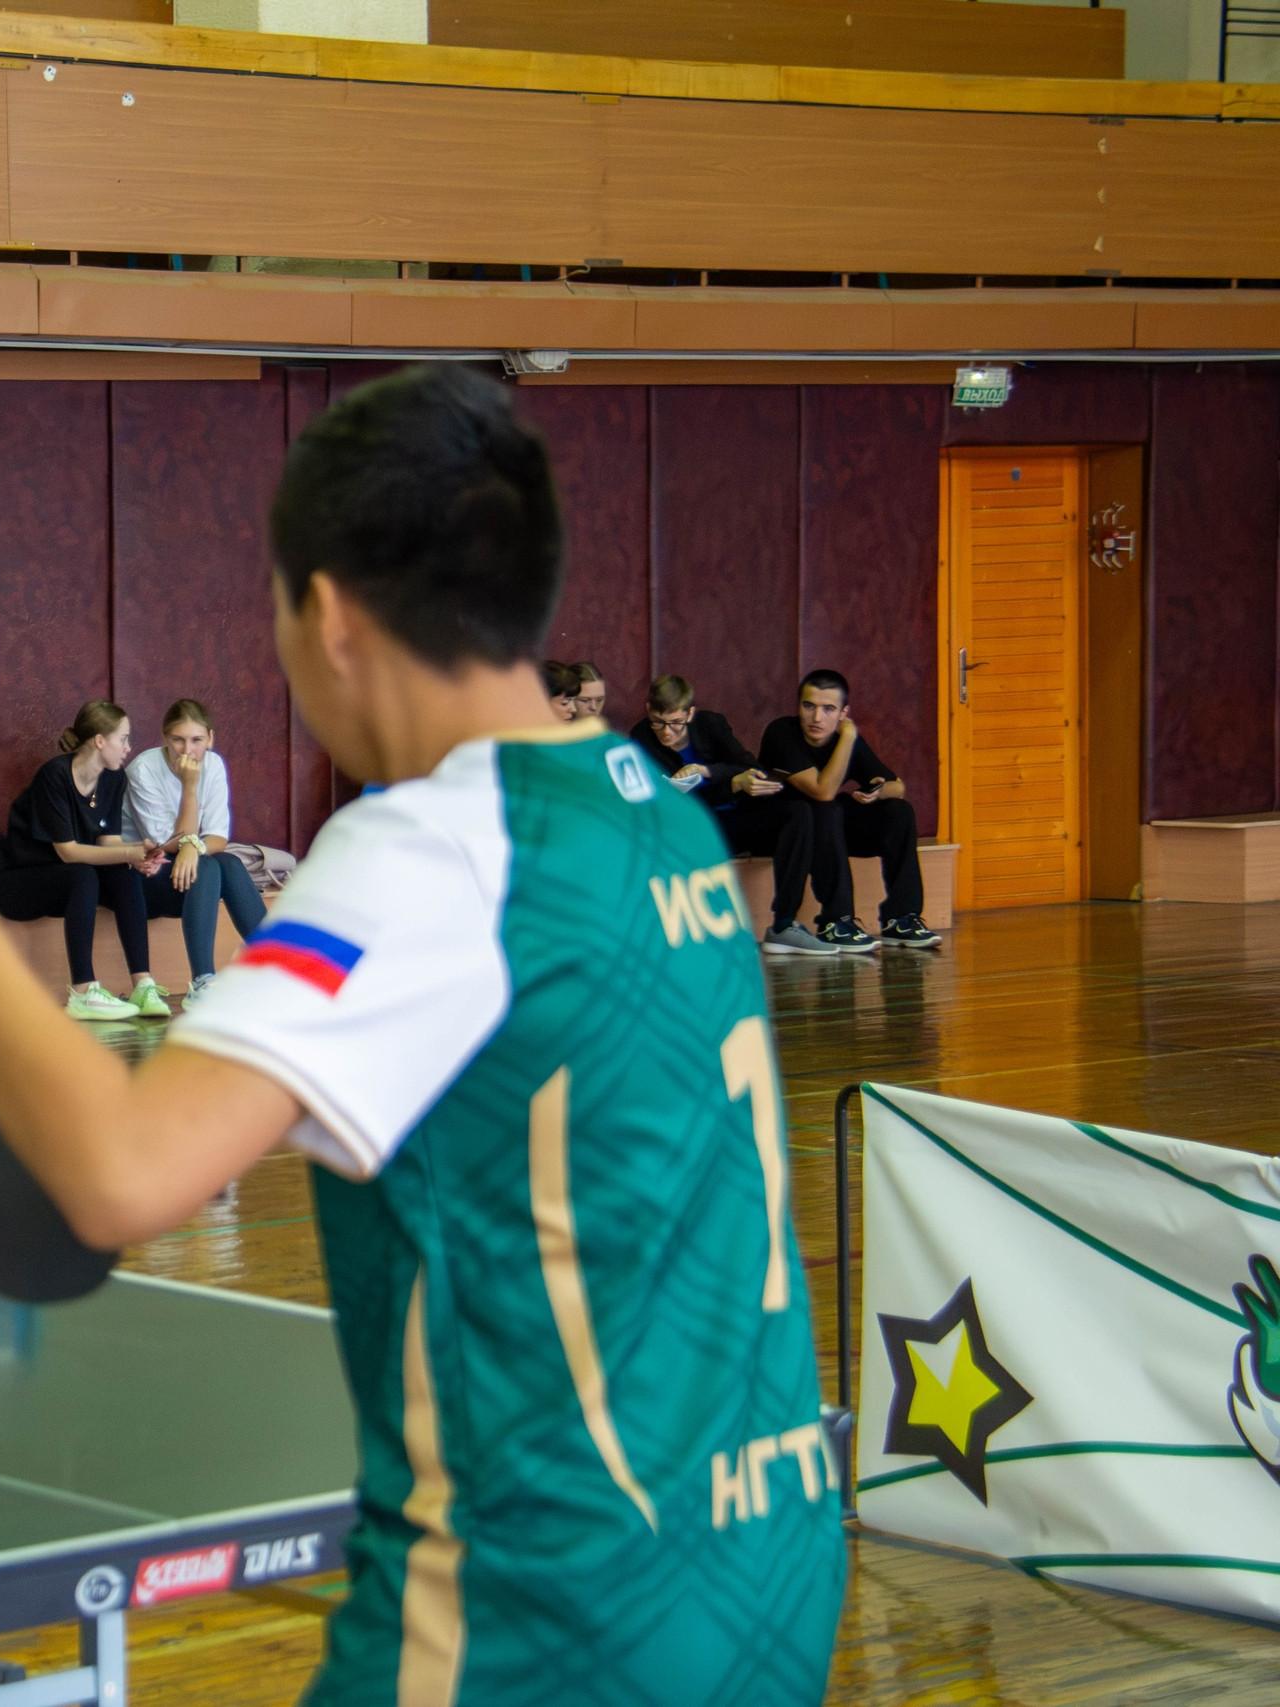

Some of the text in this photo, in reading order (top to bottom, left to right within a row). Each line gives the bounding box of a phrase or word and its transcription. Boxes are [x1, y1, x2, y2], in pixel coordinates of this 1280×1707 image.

[962, 387, 1006, 402] ВЫХОД
[720, 1014, 789, 1314] 1
[243, 1532, 324, 1580] DHS
